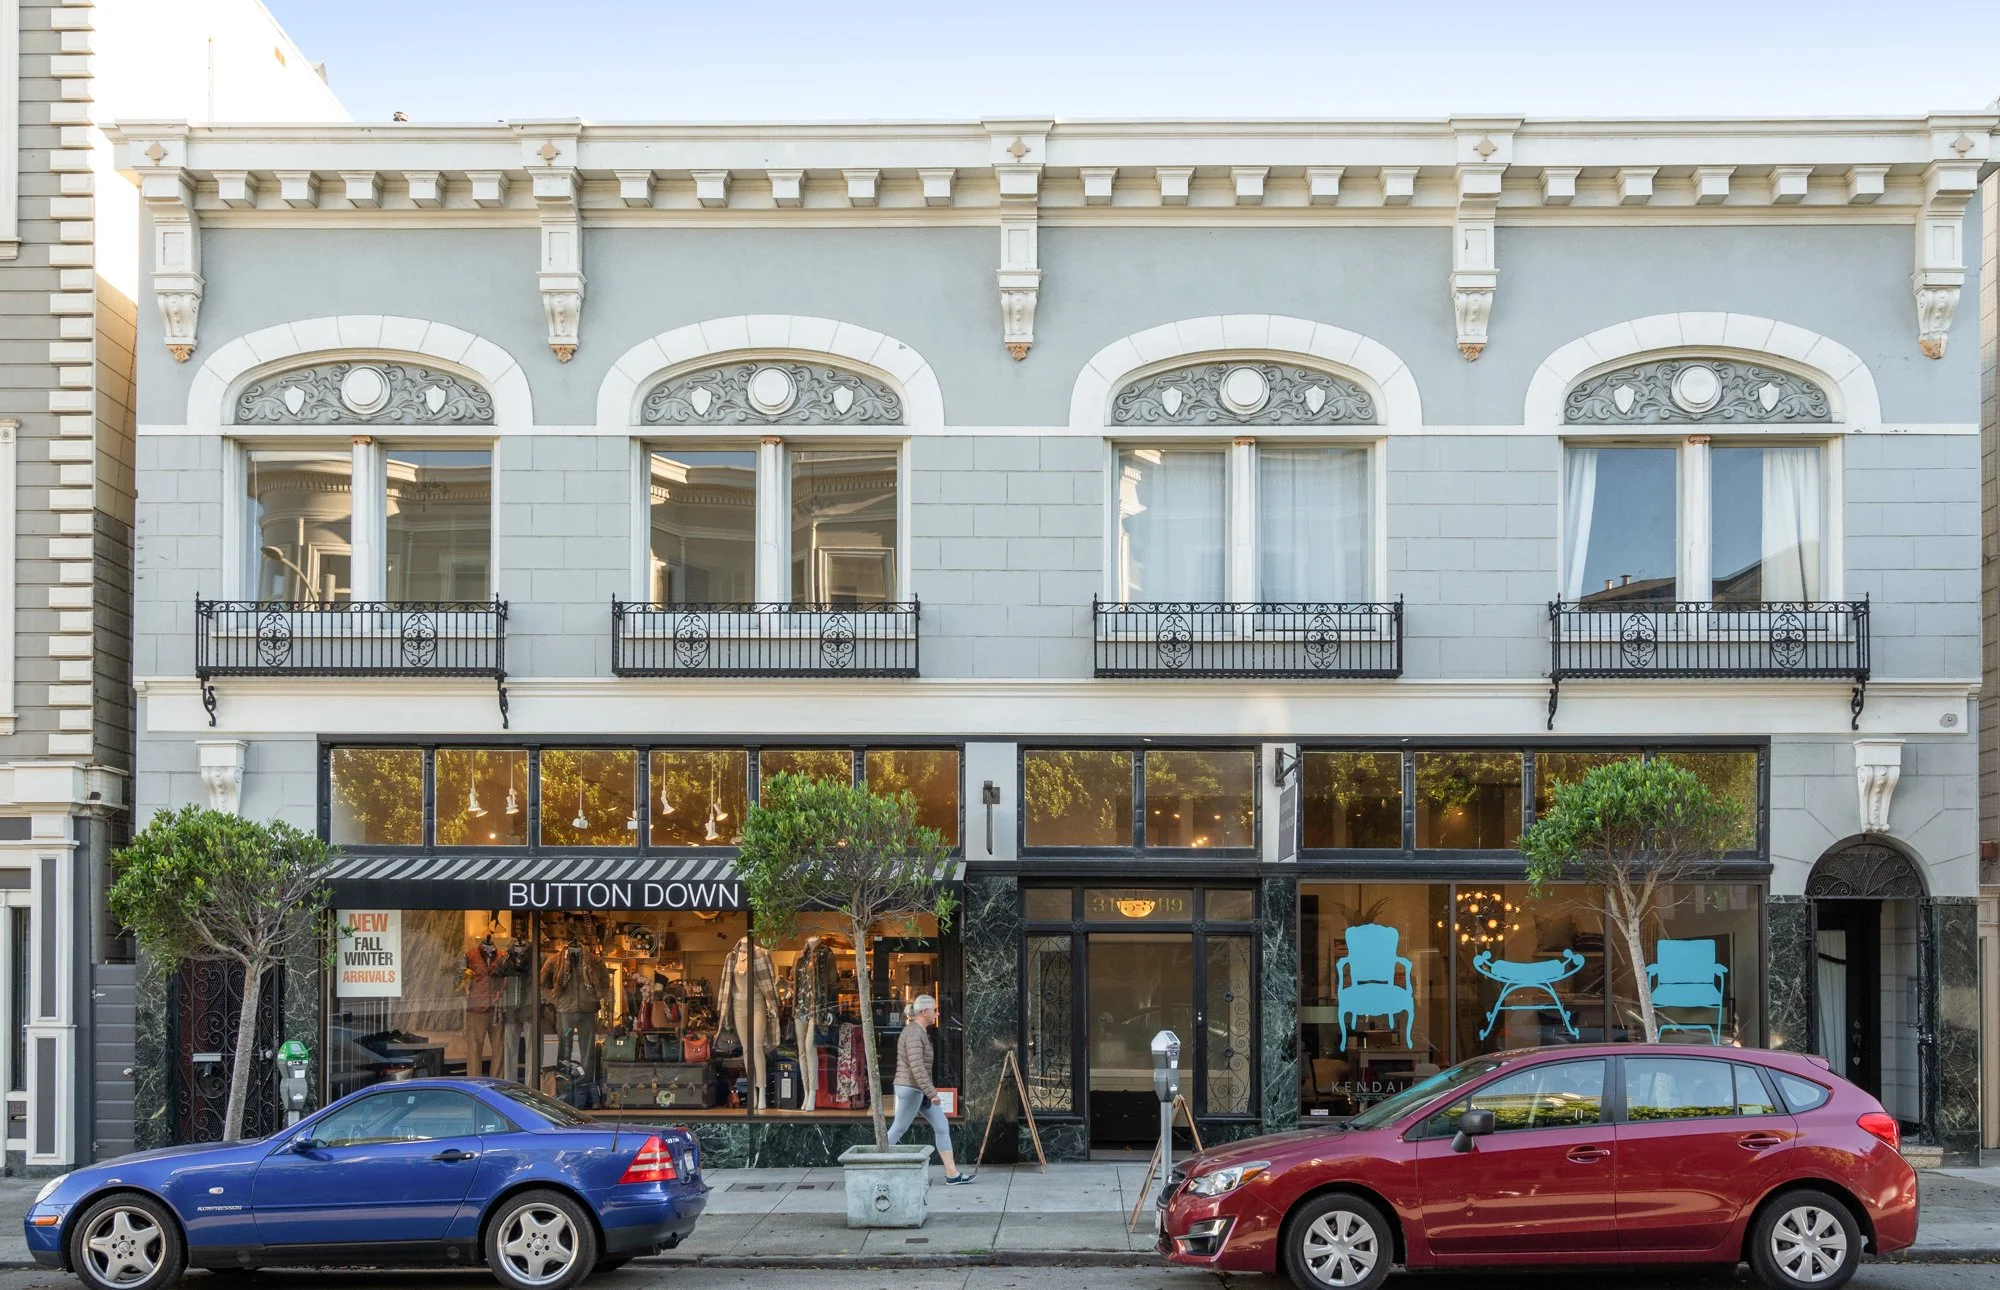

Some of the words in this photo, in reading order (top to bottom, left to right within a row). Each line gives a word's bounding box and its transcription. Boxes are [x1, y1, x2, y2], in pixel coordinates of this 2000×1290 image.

[509, 882, 631, 908] BUTTON
[644, 882, 739, 908] DOWN
[348, 913, 389, 933] NEW
[354, 937, 383, 951] FALL
[344, 951, 394, 966] WINTER
[342, 970, 396, 983] ARRIVALS
